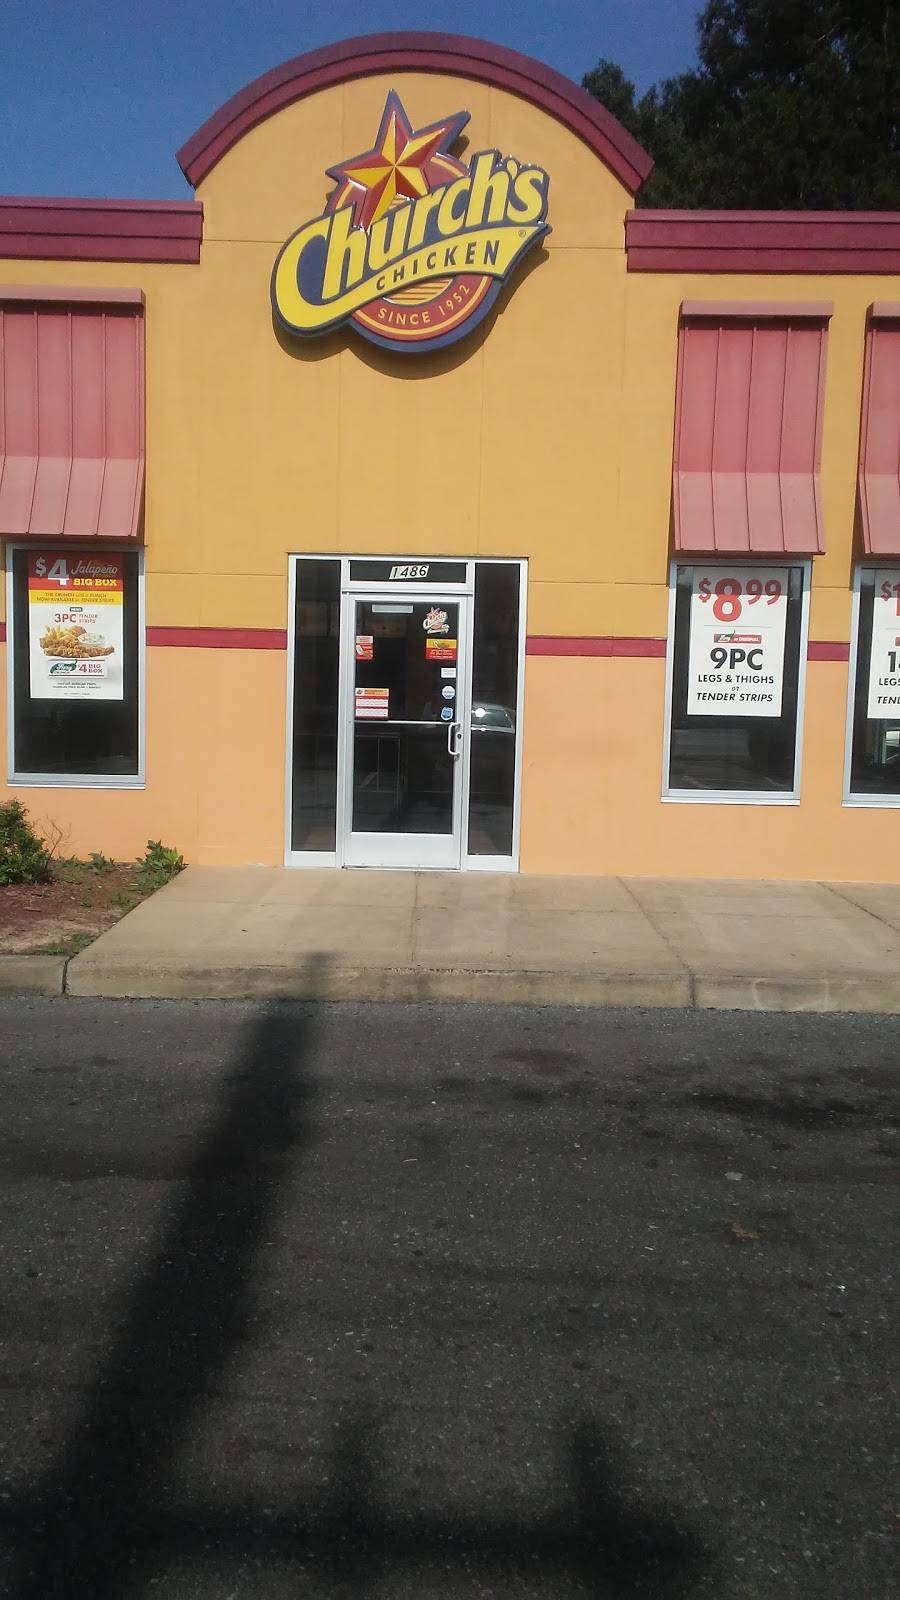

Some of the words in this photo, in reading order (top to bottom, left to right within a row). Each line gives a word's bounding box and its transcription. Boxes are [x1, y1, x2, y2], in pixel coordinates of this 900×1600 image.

[275, 152, 544, 328] Church's
[375, 239, 501, 291] CHICKEN
[377, 307, 431, 325] SINCE
[439, 285, 471, 316] 1952
[35, 556, 69, 586] $4
[71, 560, 118, 578] Jalapeño
[393, 565, 427, 578] 1486
[73, 578, 93, 586] BIG
[95, 578, 118, 587] BOX
[54, 613, 77, 623] 3PC
[710, 647, 764, 670] 9PC
[887, 651, 900, 673] 1
[698, 674, 722, 683] LEGS
[725, 674, 732, 683] &
[735, 675, 774, 684] THIGHS
[696, 692, 736, 701] TENDER
[739, 693, 773, 702] STRIPS
